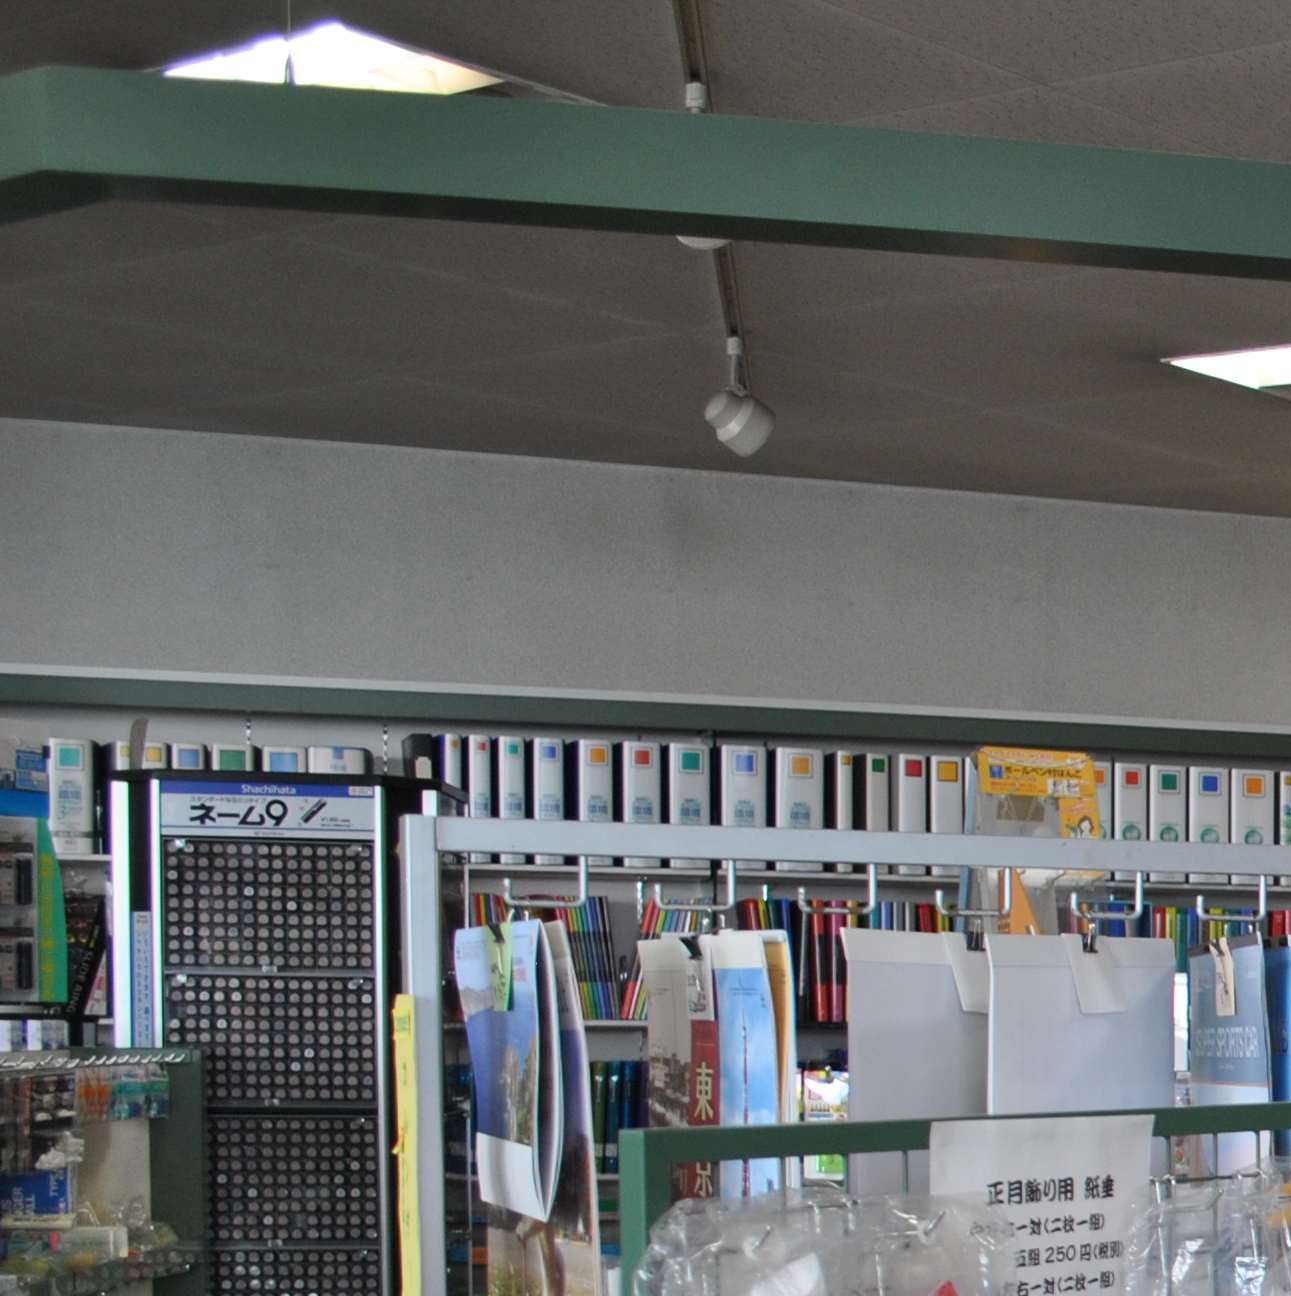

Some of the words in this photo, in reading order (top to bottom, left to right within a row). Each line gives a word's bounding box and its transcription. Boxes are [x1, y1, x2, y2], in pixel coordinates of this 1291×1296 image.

[241, 784, 297, 796] Shachihata
[189, 799, 289, 827] ネーム9
[1217, 1027, 1243, 1058] SPORTS
[1244, 1026, 1259, 1058] CAR
